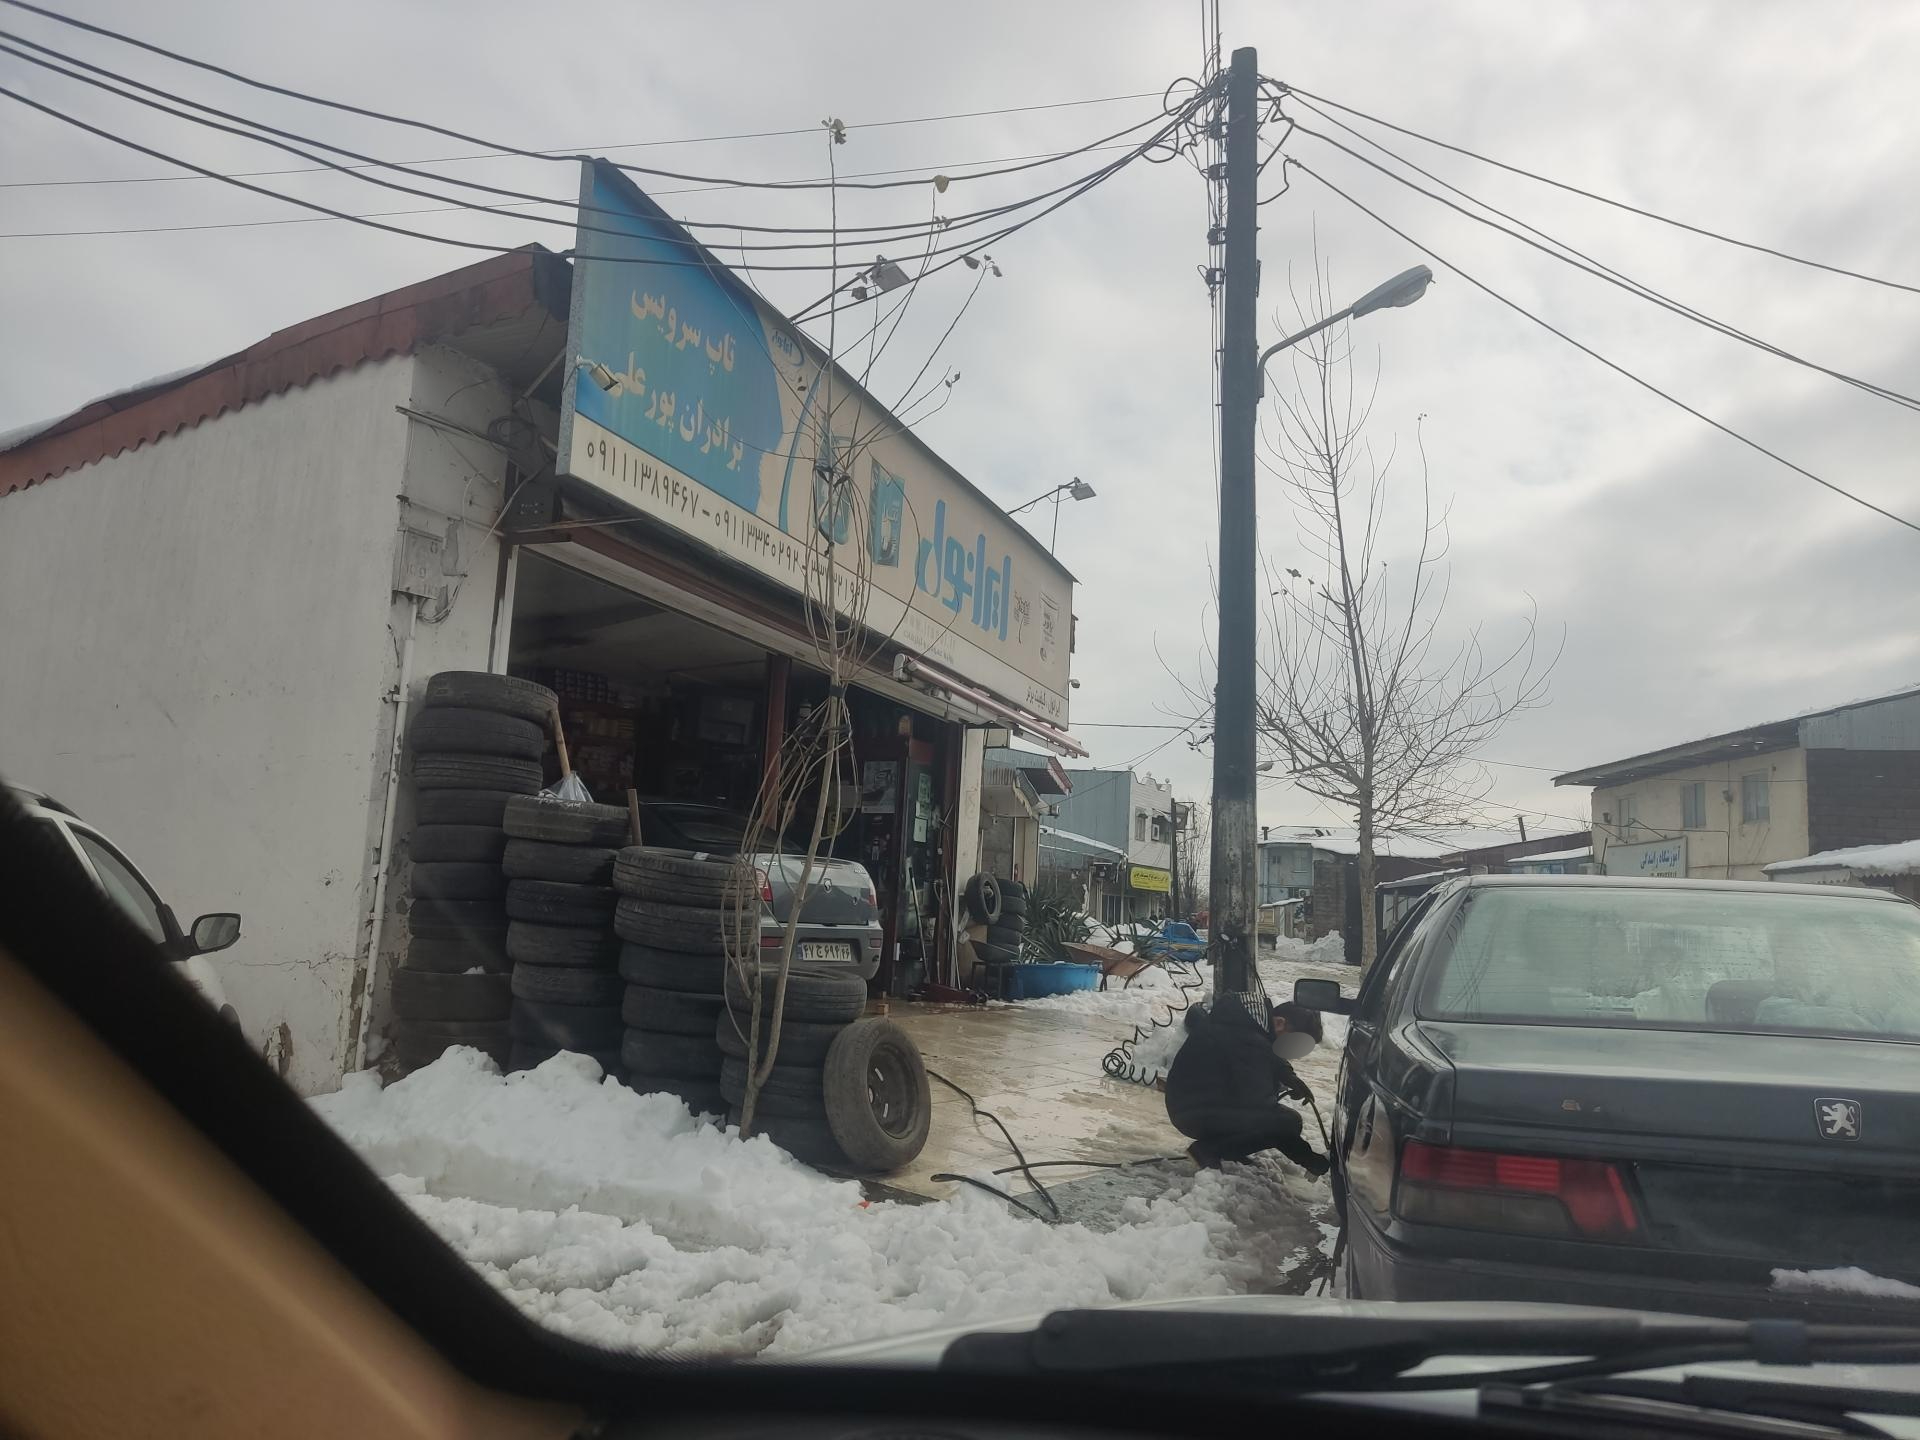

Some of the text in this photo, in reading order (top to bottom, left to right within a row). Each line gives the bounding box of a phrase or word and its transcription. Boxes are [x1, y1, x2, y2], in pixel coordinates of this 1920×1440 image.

[632, 290, 736, 376] تاپ سرویس
[680, 398, 743, 473] برادران
[587, 439, 699, 518] ۰۹۱۱۱۳۸۹۴۶۷
[916, 498, 1012, 642] ایرانول
